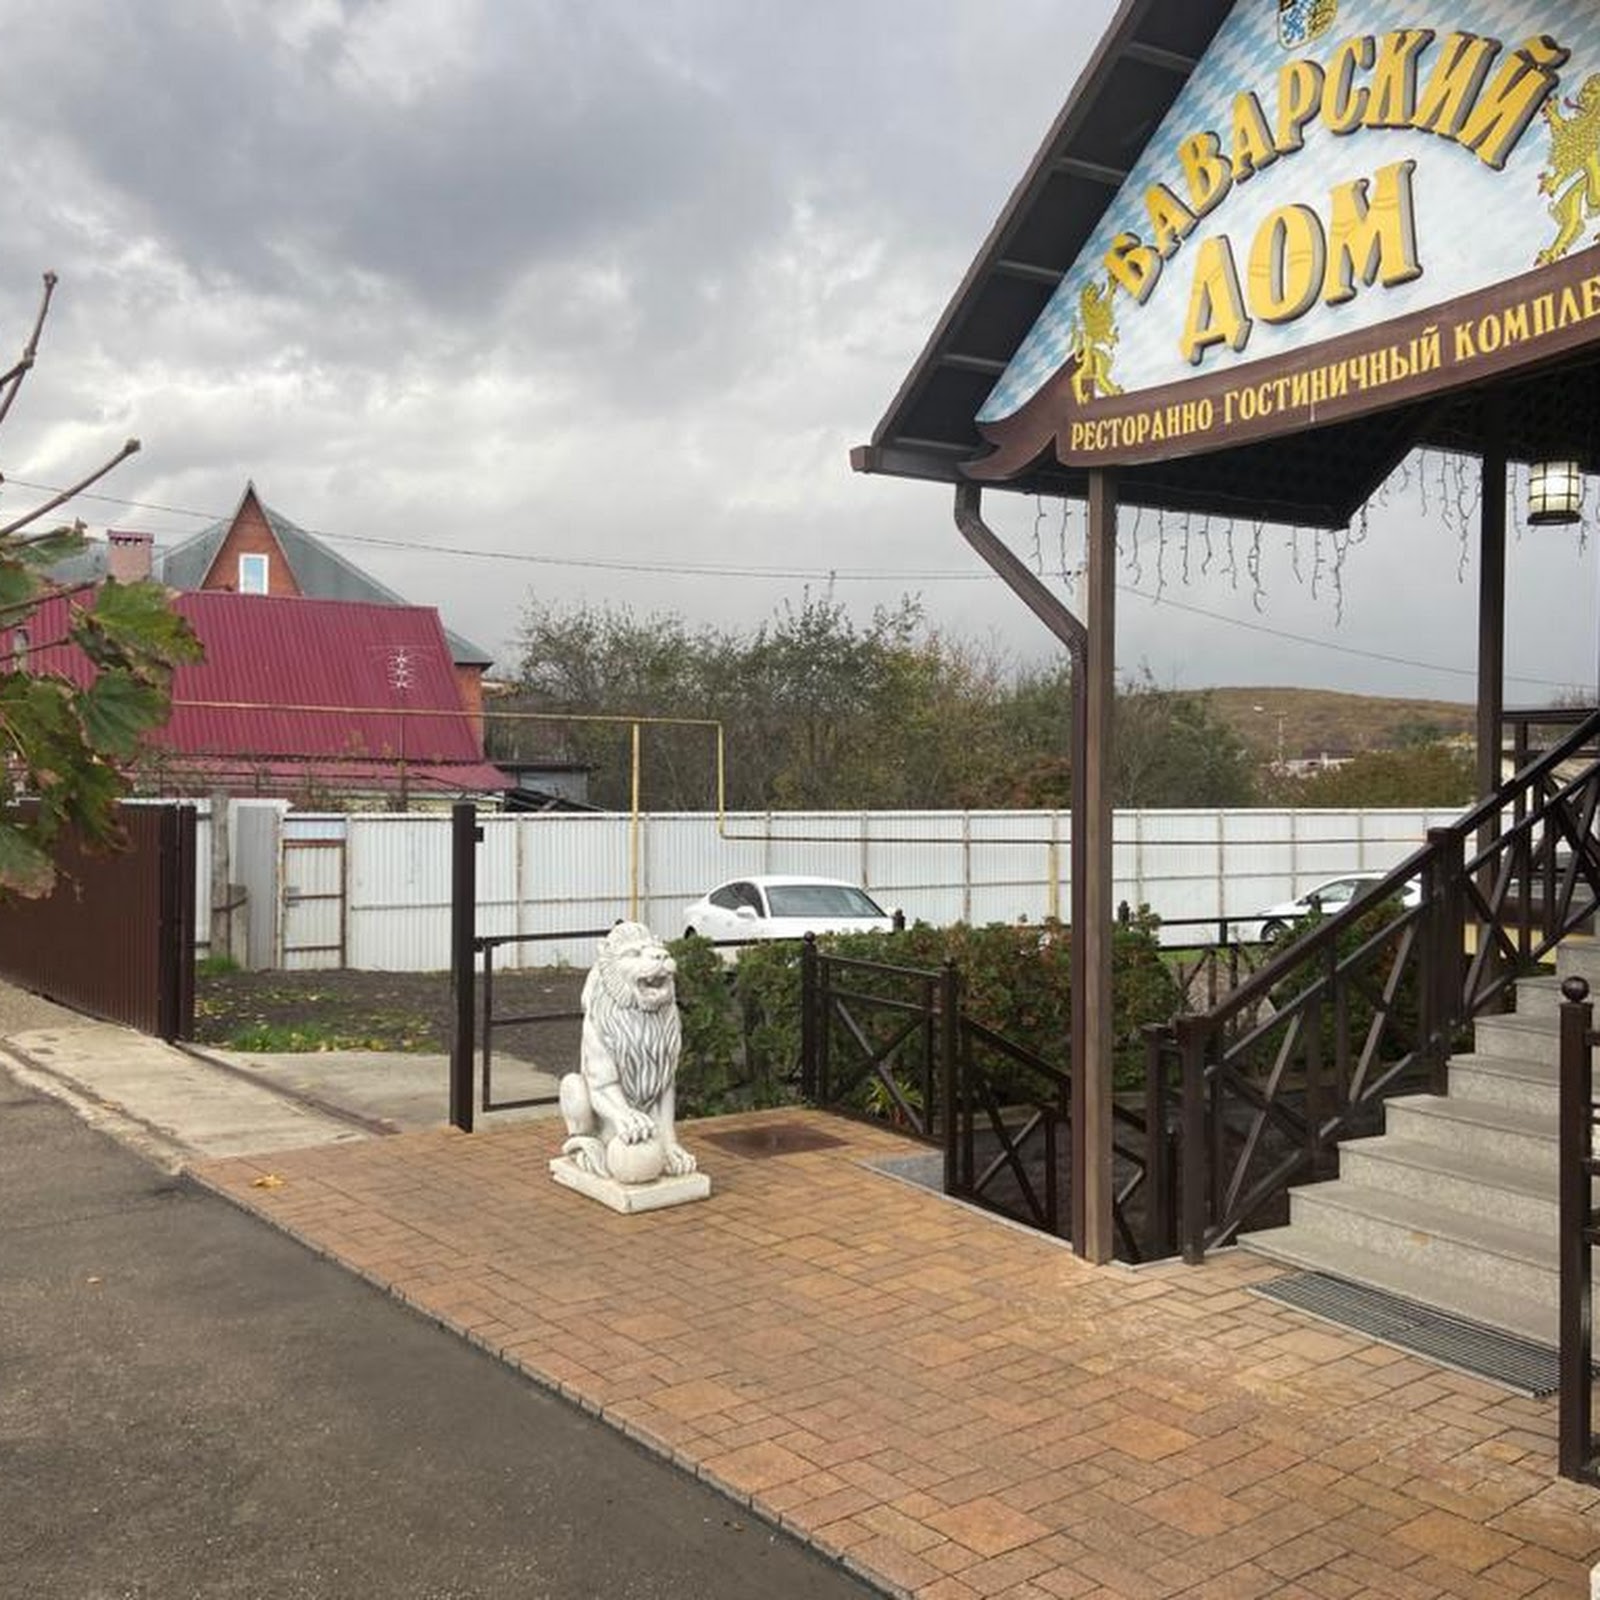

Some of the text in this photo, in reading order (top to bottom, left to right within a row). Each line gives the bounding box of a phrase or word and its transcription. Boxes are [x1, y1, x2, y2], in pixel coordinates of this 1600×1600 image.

[1104, 30, 1570, 304] БАВАРСКИЙ
[1180, 160, 1422, 365] ДОМ
[1070, 399, 1214, 452] РЕСТОРАННО
[1223, 327, 1442, 424] ГОСТИНИЧНЫЙ
